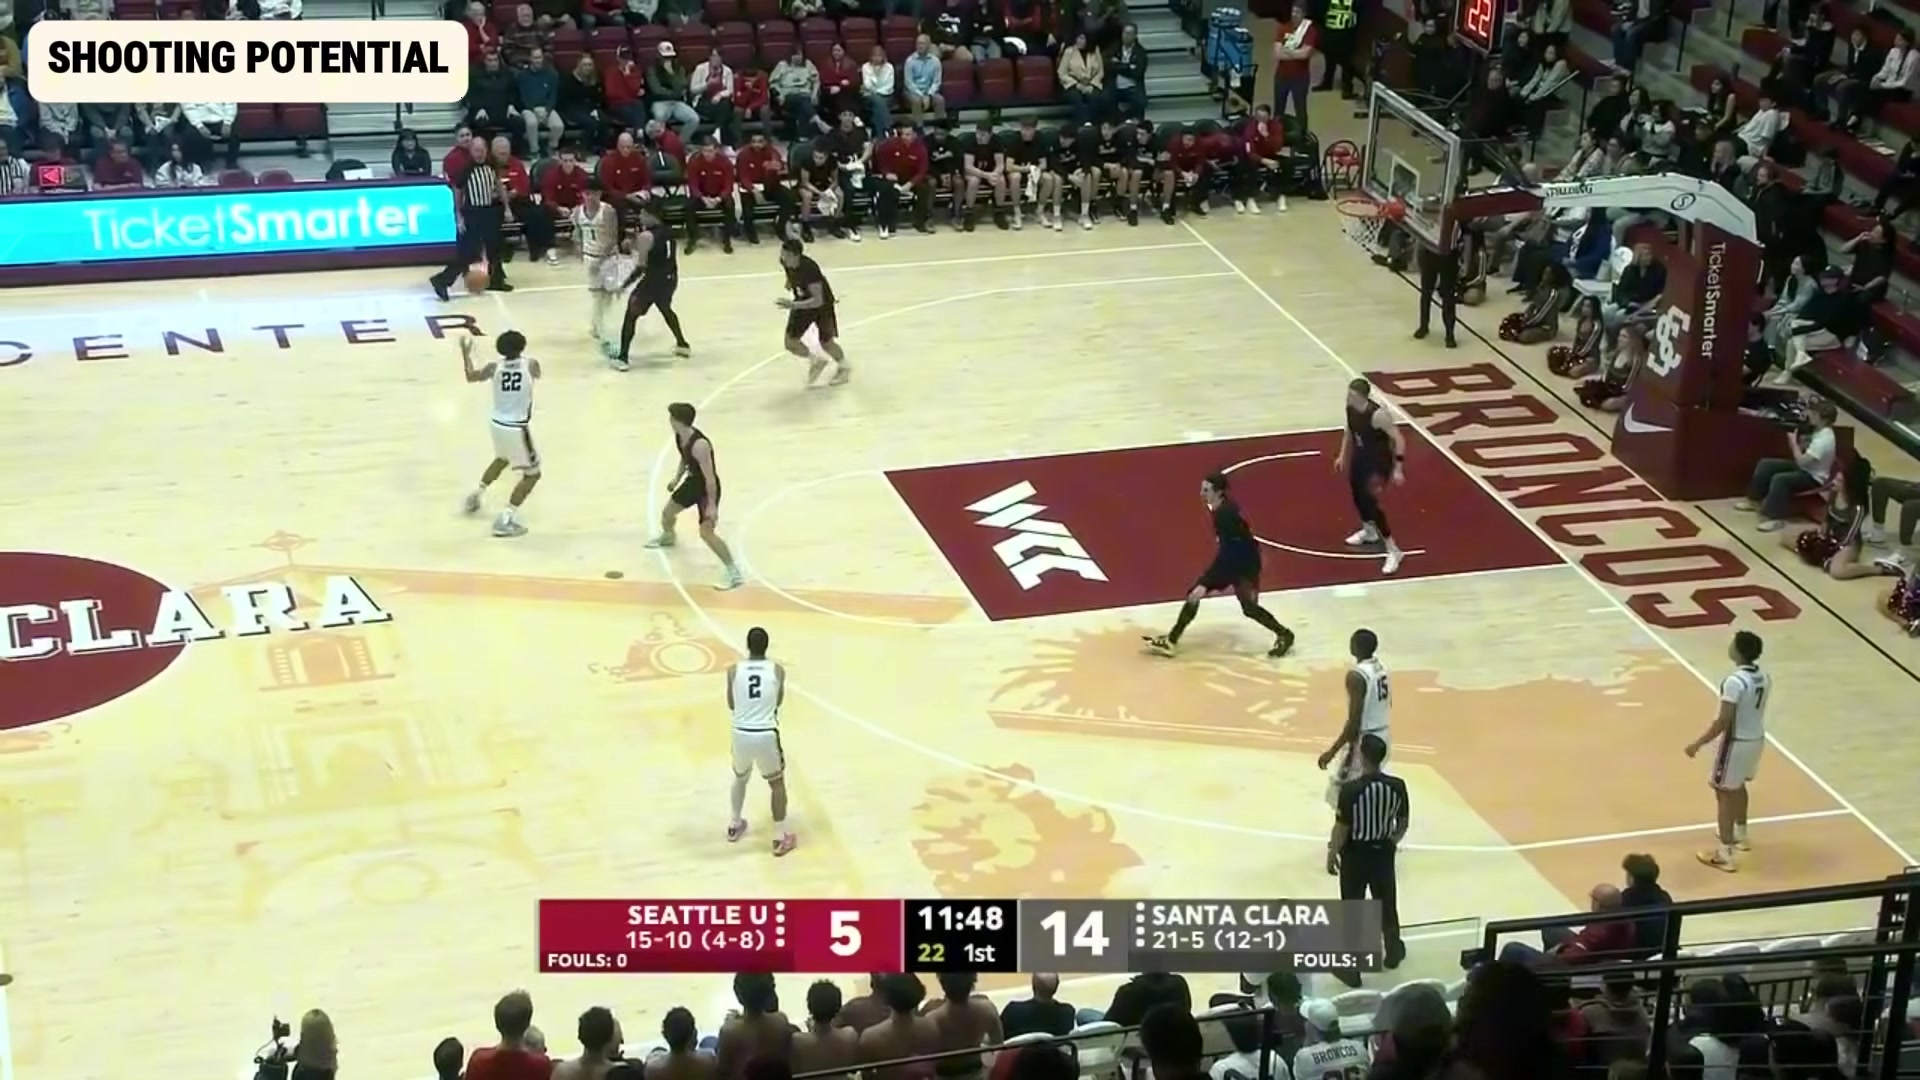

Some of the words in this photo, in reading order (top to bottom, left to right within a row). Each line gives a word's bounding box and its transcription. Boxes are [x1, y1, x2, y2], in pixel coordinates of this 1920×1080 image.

[1468, 0, 1491, 37] 22
[83, 197, 429, 251] TicketSmarter
[1701, 241, 1726, 360] TicketSmarter
[501, 371, 522, 392] 22
[1362, 363, 1802, 629] BRONCOS
[0, 575, 394, 661] CLARA
[748, 674, 761, 699] 2
[1377, 675, 1388, 702] 15
[1755, 687, 1764, 710] 7
[1311, 1045, 1357, 1065] BRONCOS
